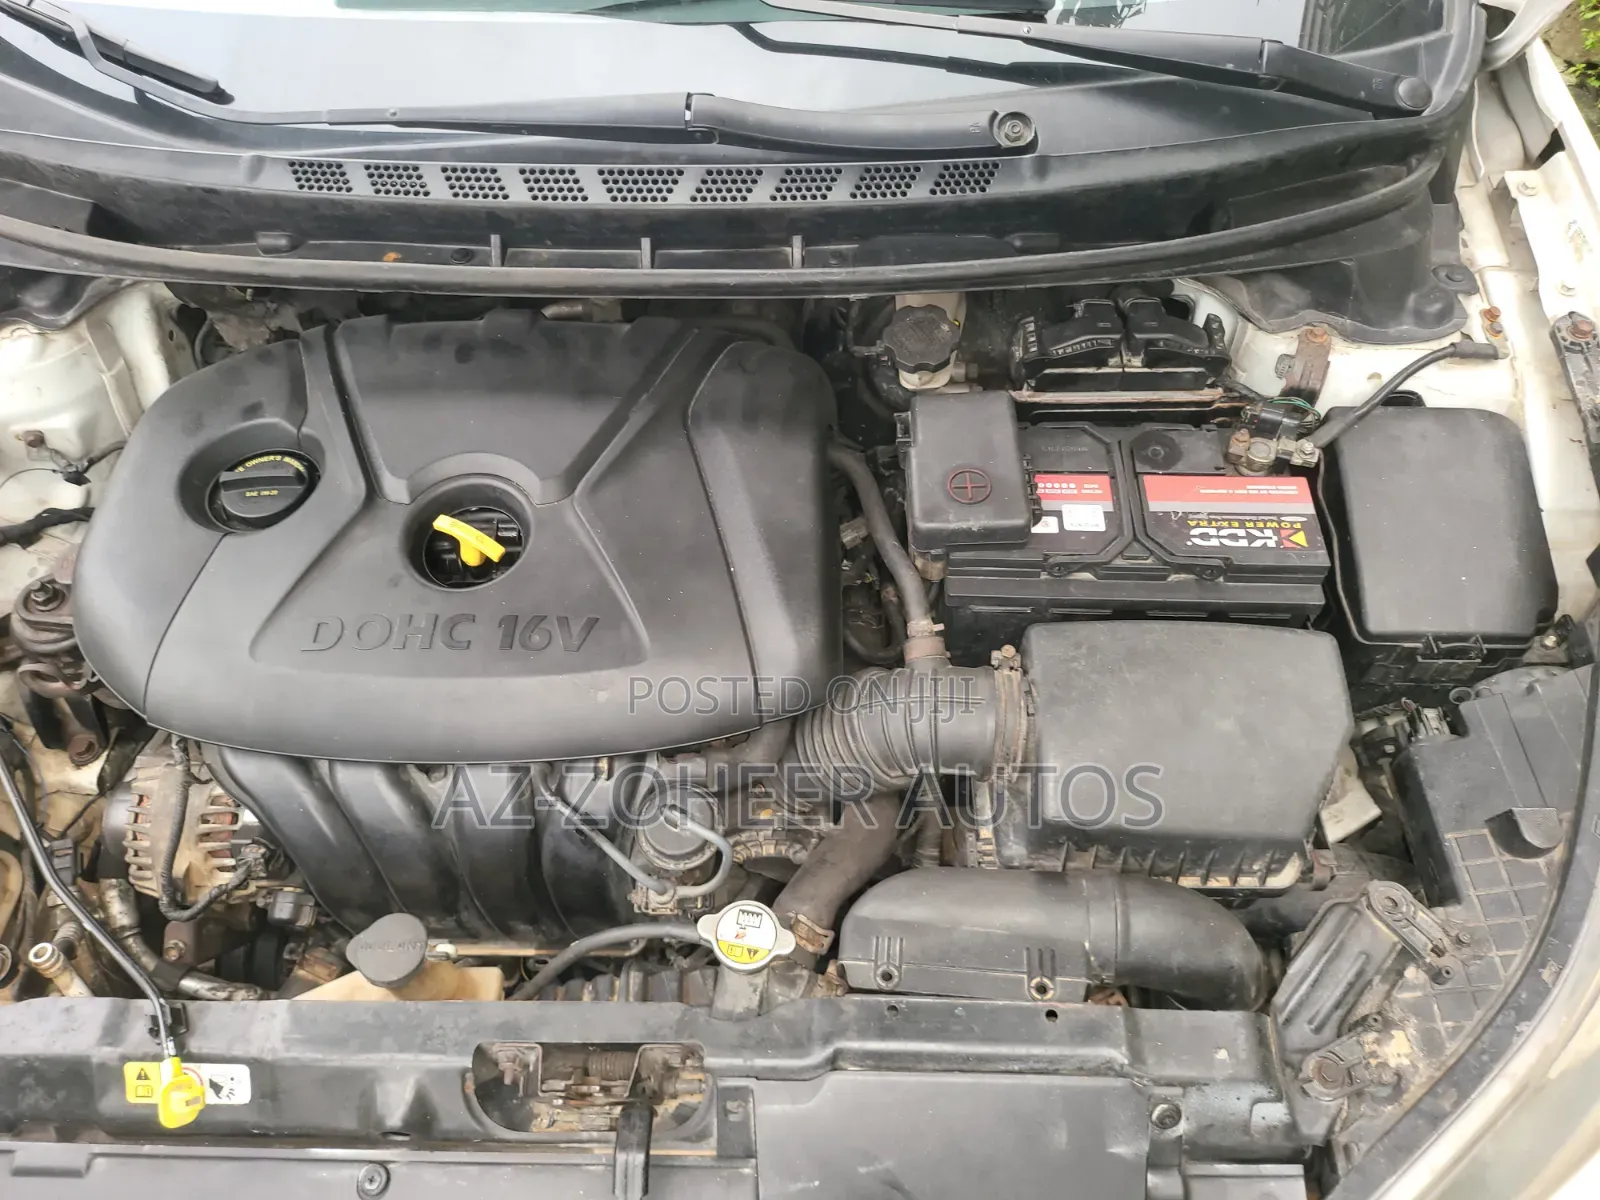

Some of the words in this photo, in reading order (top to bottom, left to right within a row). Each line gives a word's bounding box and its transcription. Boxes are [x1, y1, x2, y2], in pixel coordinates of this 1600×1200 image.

[1189, 527, 1278, 547] KDD
[301, 614, 476, 651] DOHC
[498, 614, 600, 652] 16V
